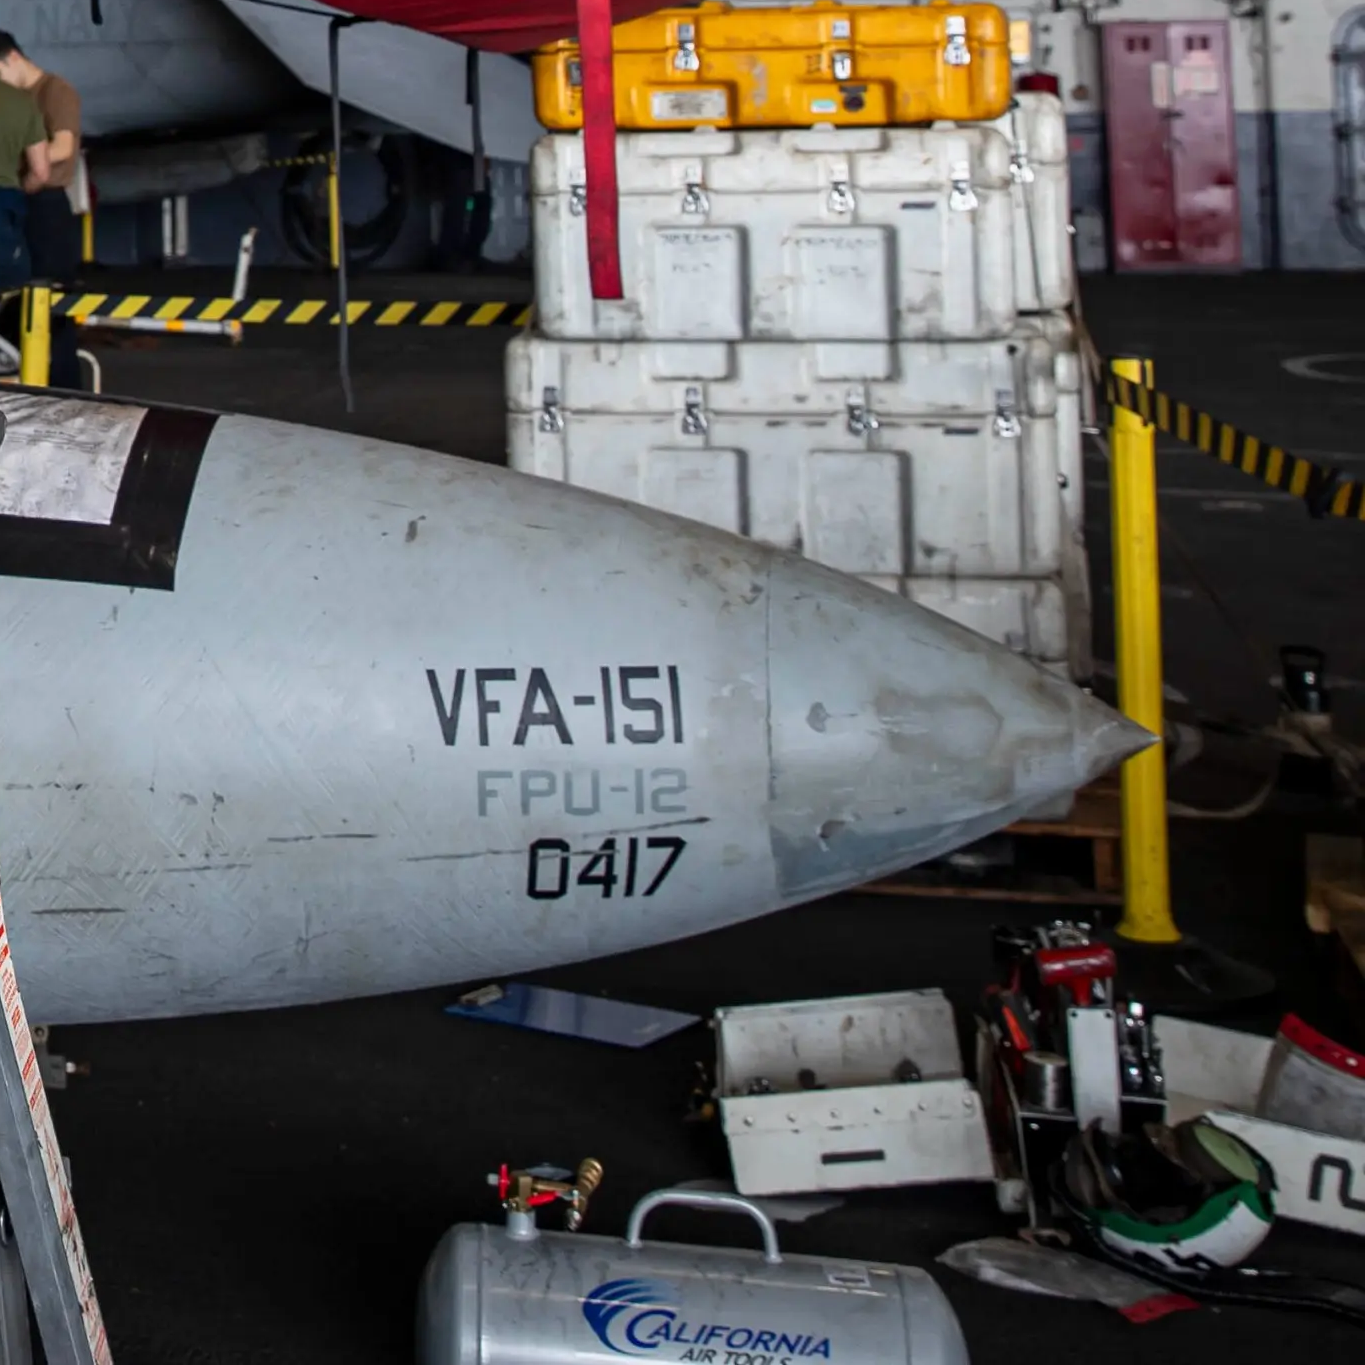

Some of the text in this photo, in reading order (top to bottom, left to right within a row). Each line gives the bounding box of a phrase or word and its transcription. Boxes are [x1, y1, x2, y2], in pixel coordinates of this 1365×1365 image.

[426, 665, 685, 747] VFA-151
[477, 768, 687, 817] FPU-12
[526, 837, 687, 900] 0417
[625, 1308, 831, 1359] CALIFORNIA
[679, 1347, 792, 1365] AIR TOOLS
